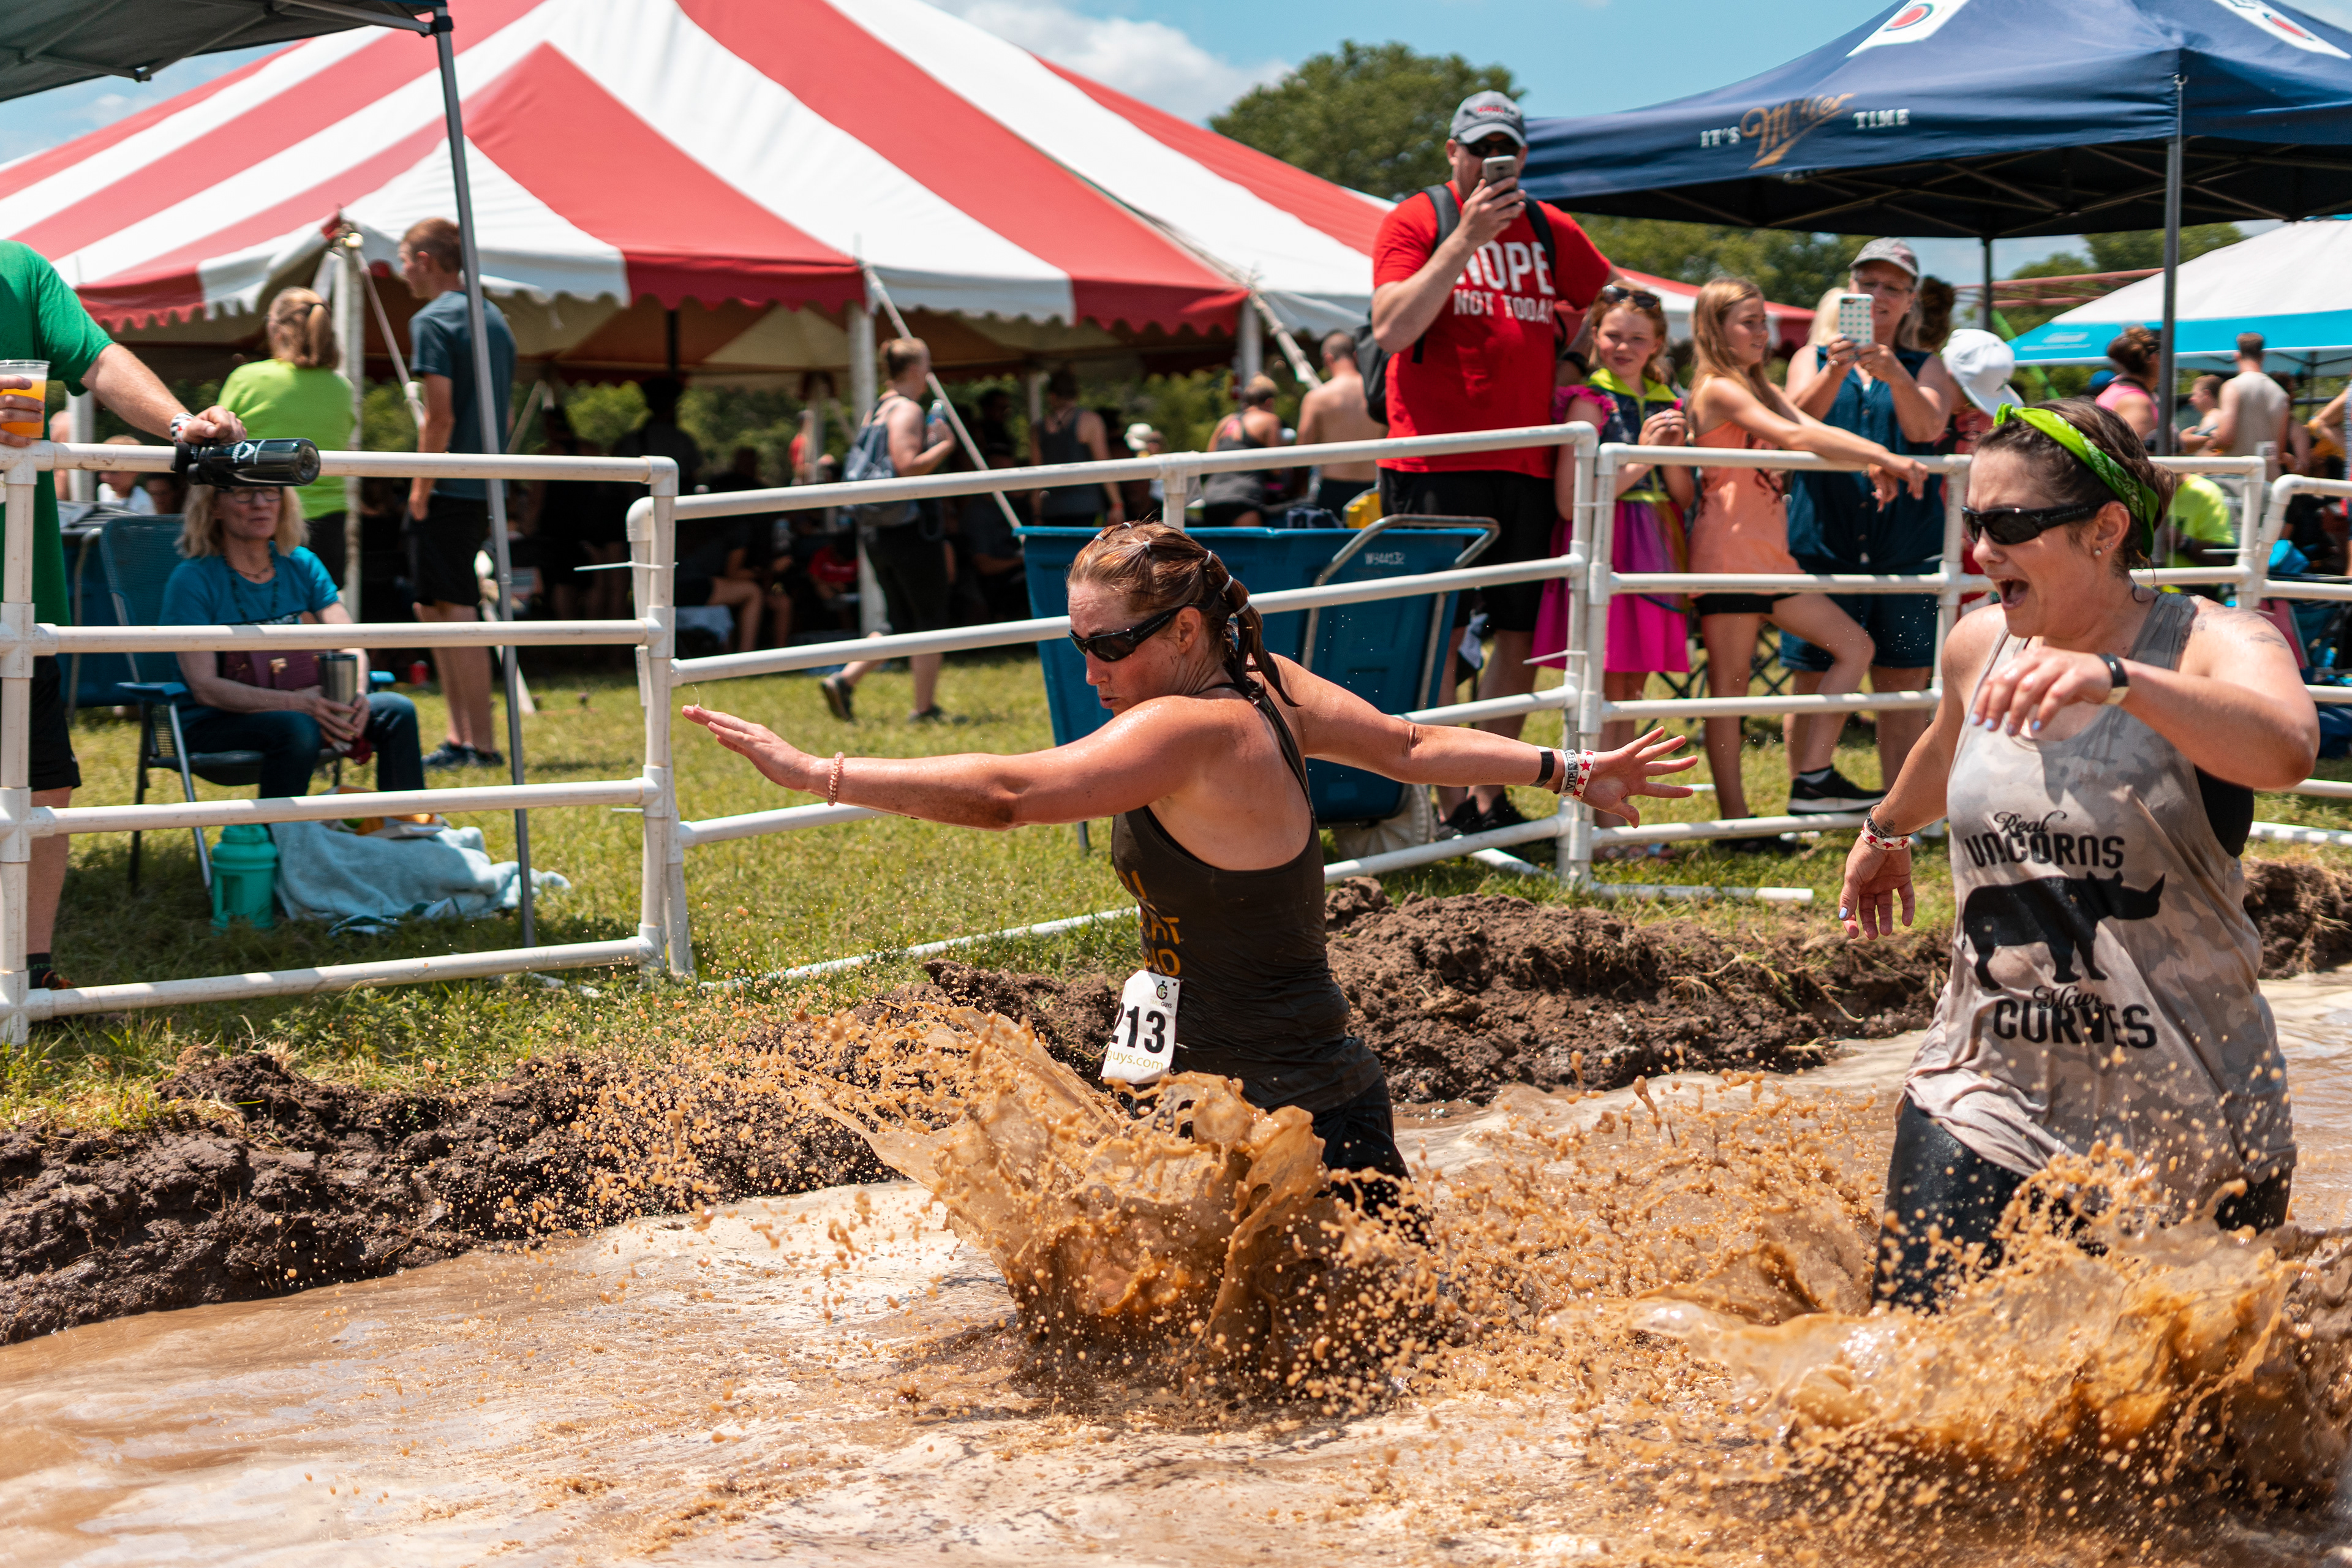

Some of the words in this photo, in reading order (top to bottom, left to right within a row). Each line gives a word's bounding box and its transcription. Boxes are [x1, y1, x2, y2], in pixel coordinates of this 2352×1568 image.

[1700, 126, 1741, 148] IT'S
[1853, 108, 1910, 130] TIME
[1453, 289, 1495, 316] NOT
[1566, 772, 1577, 790] VIP
[1994, 810, 2068, 837] Real
[1964, 832, 2125, 869] UNCORNS
[1994, 998, 2158, 1049] CURVES
